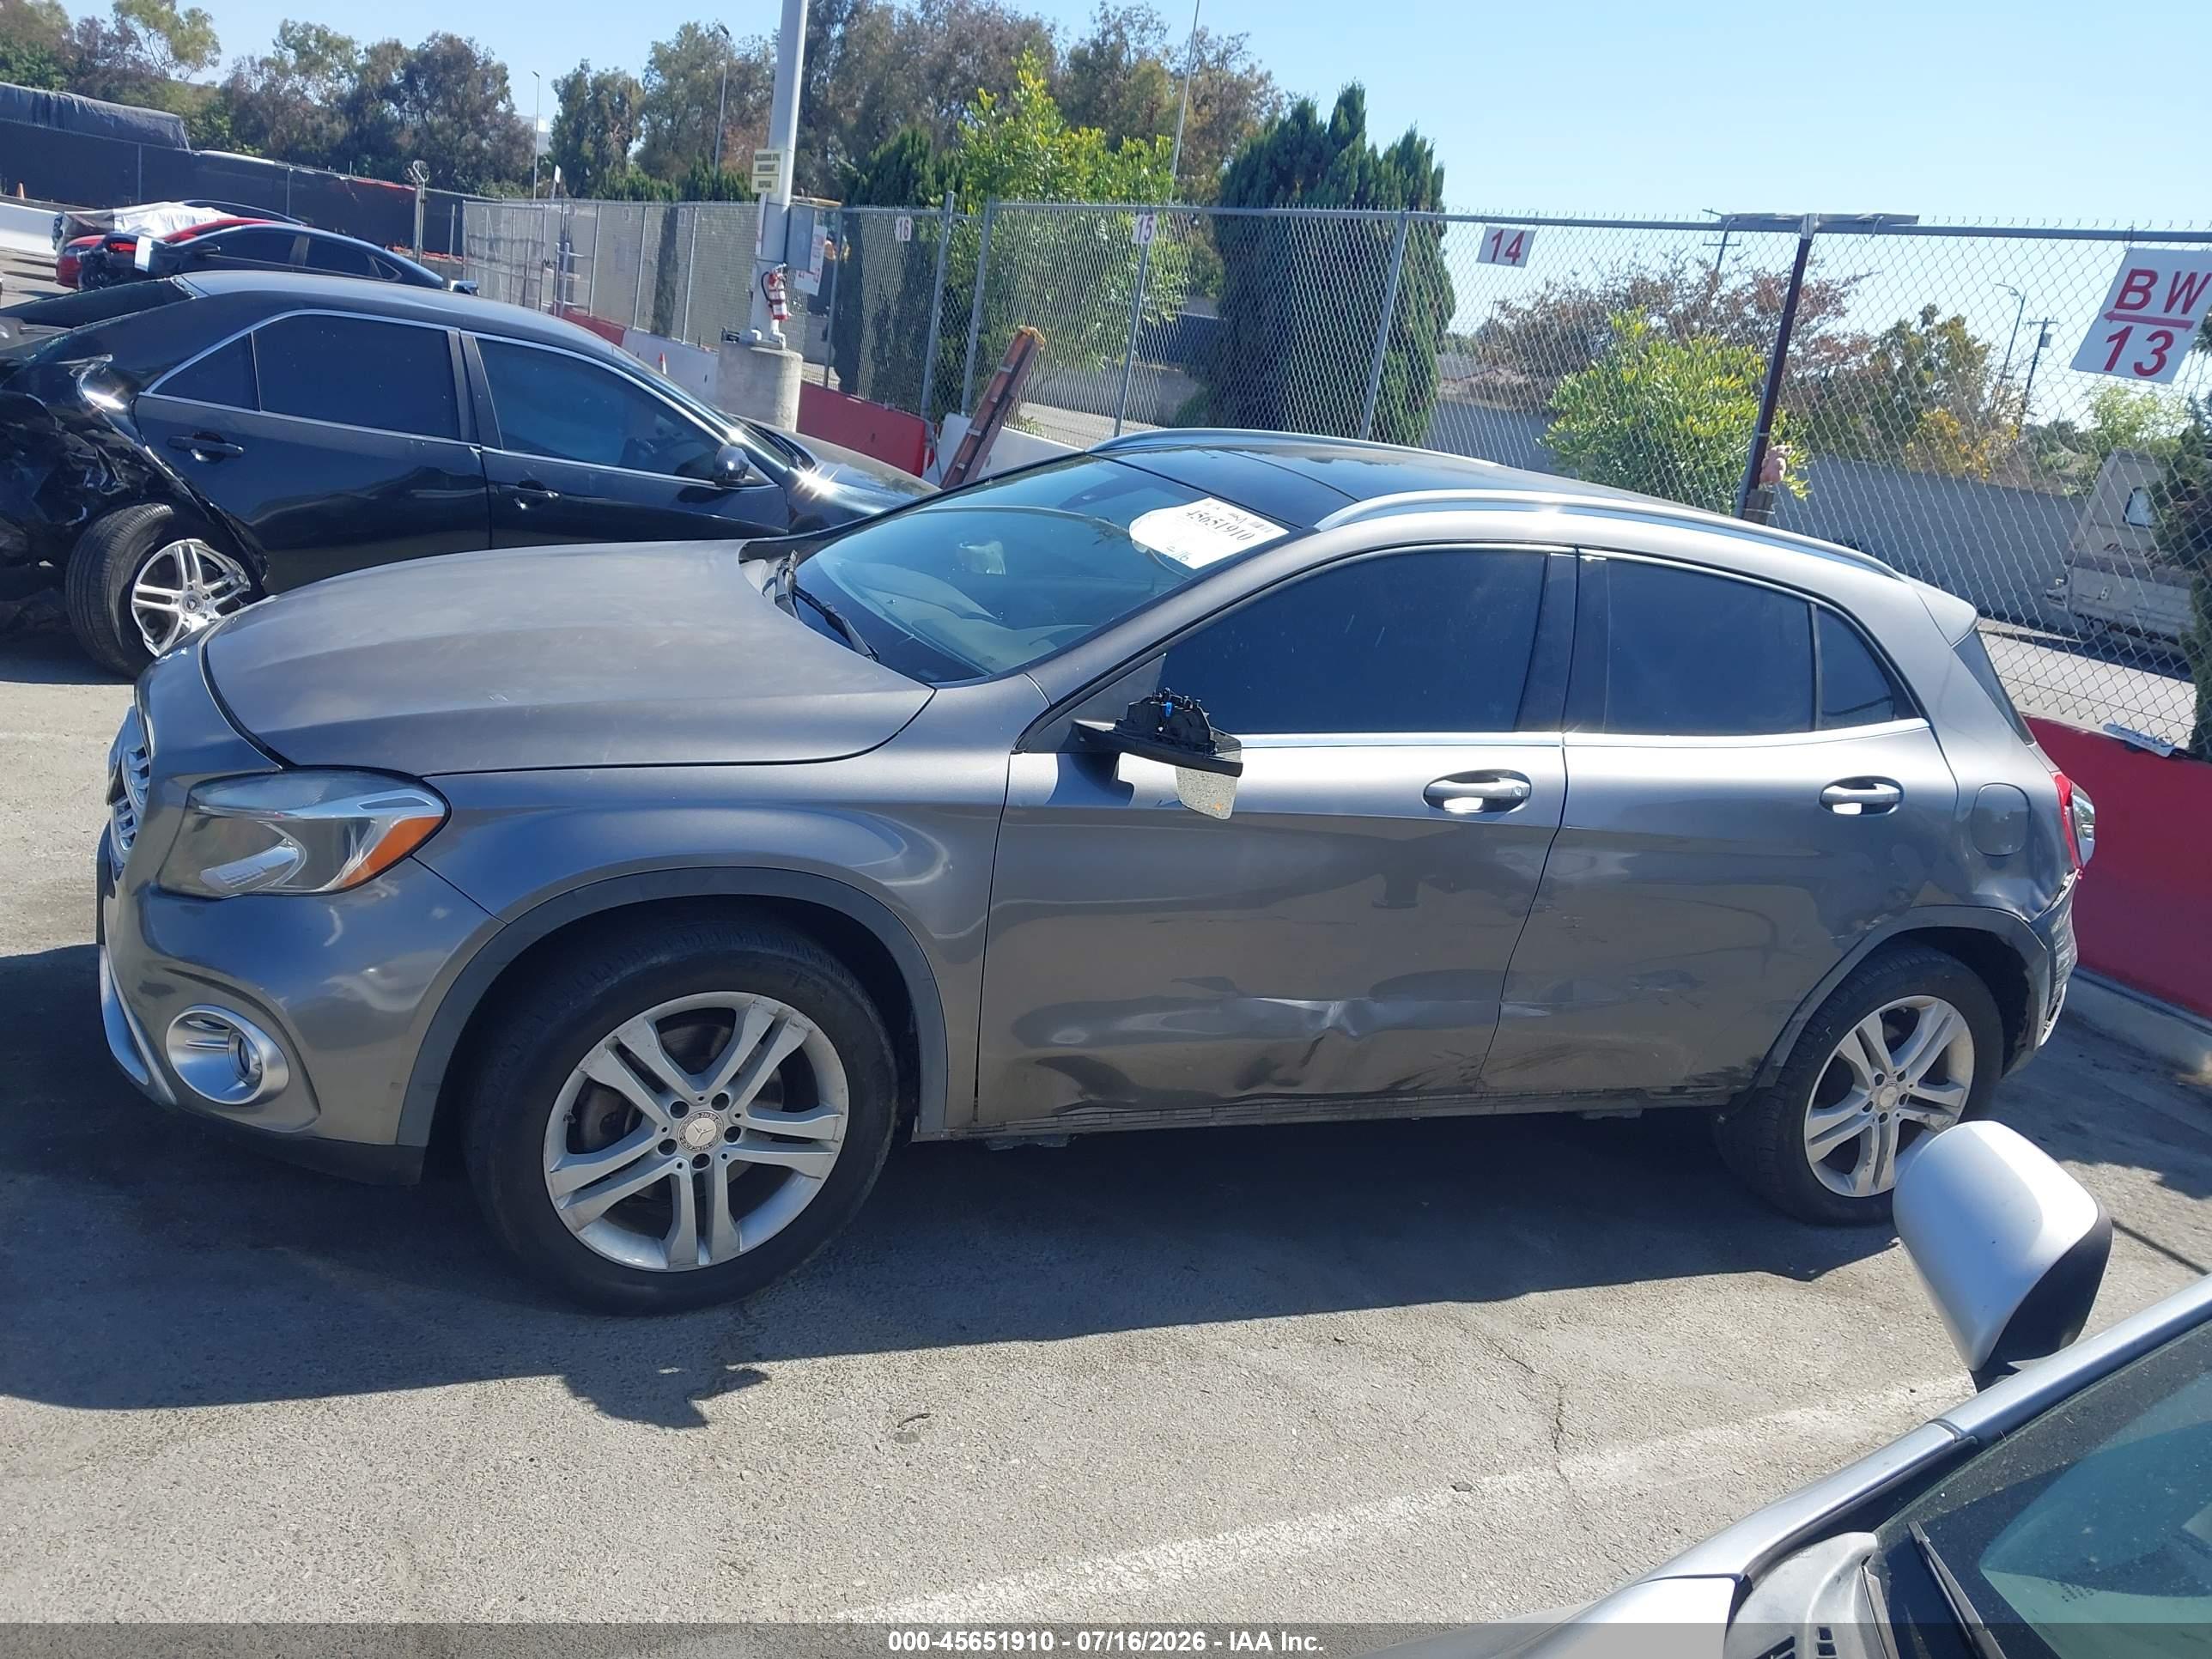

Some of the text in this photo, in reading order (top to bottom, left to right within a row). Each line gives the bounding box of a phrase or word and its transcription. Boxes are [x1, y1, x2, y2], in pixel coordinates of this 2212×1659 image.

[1138, 216, 1154, 242] 15
[1491, 228, 1525, 264] 14
[2103, 325, 2174, 377] 13
